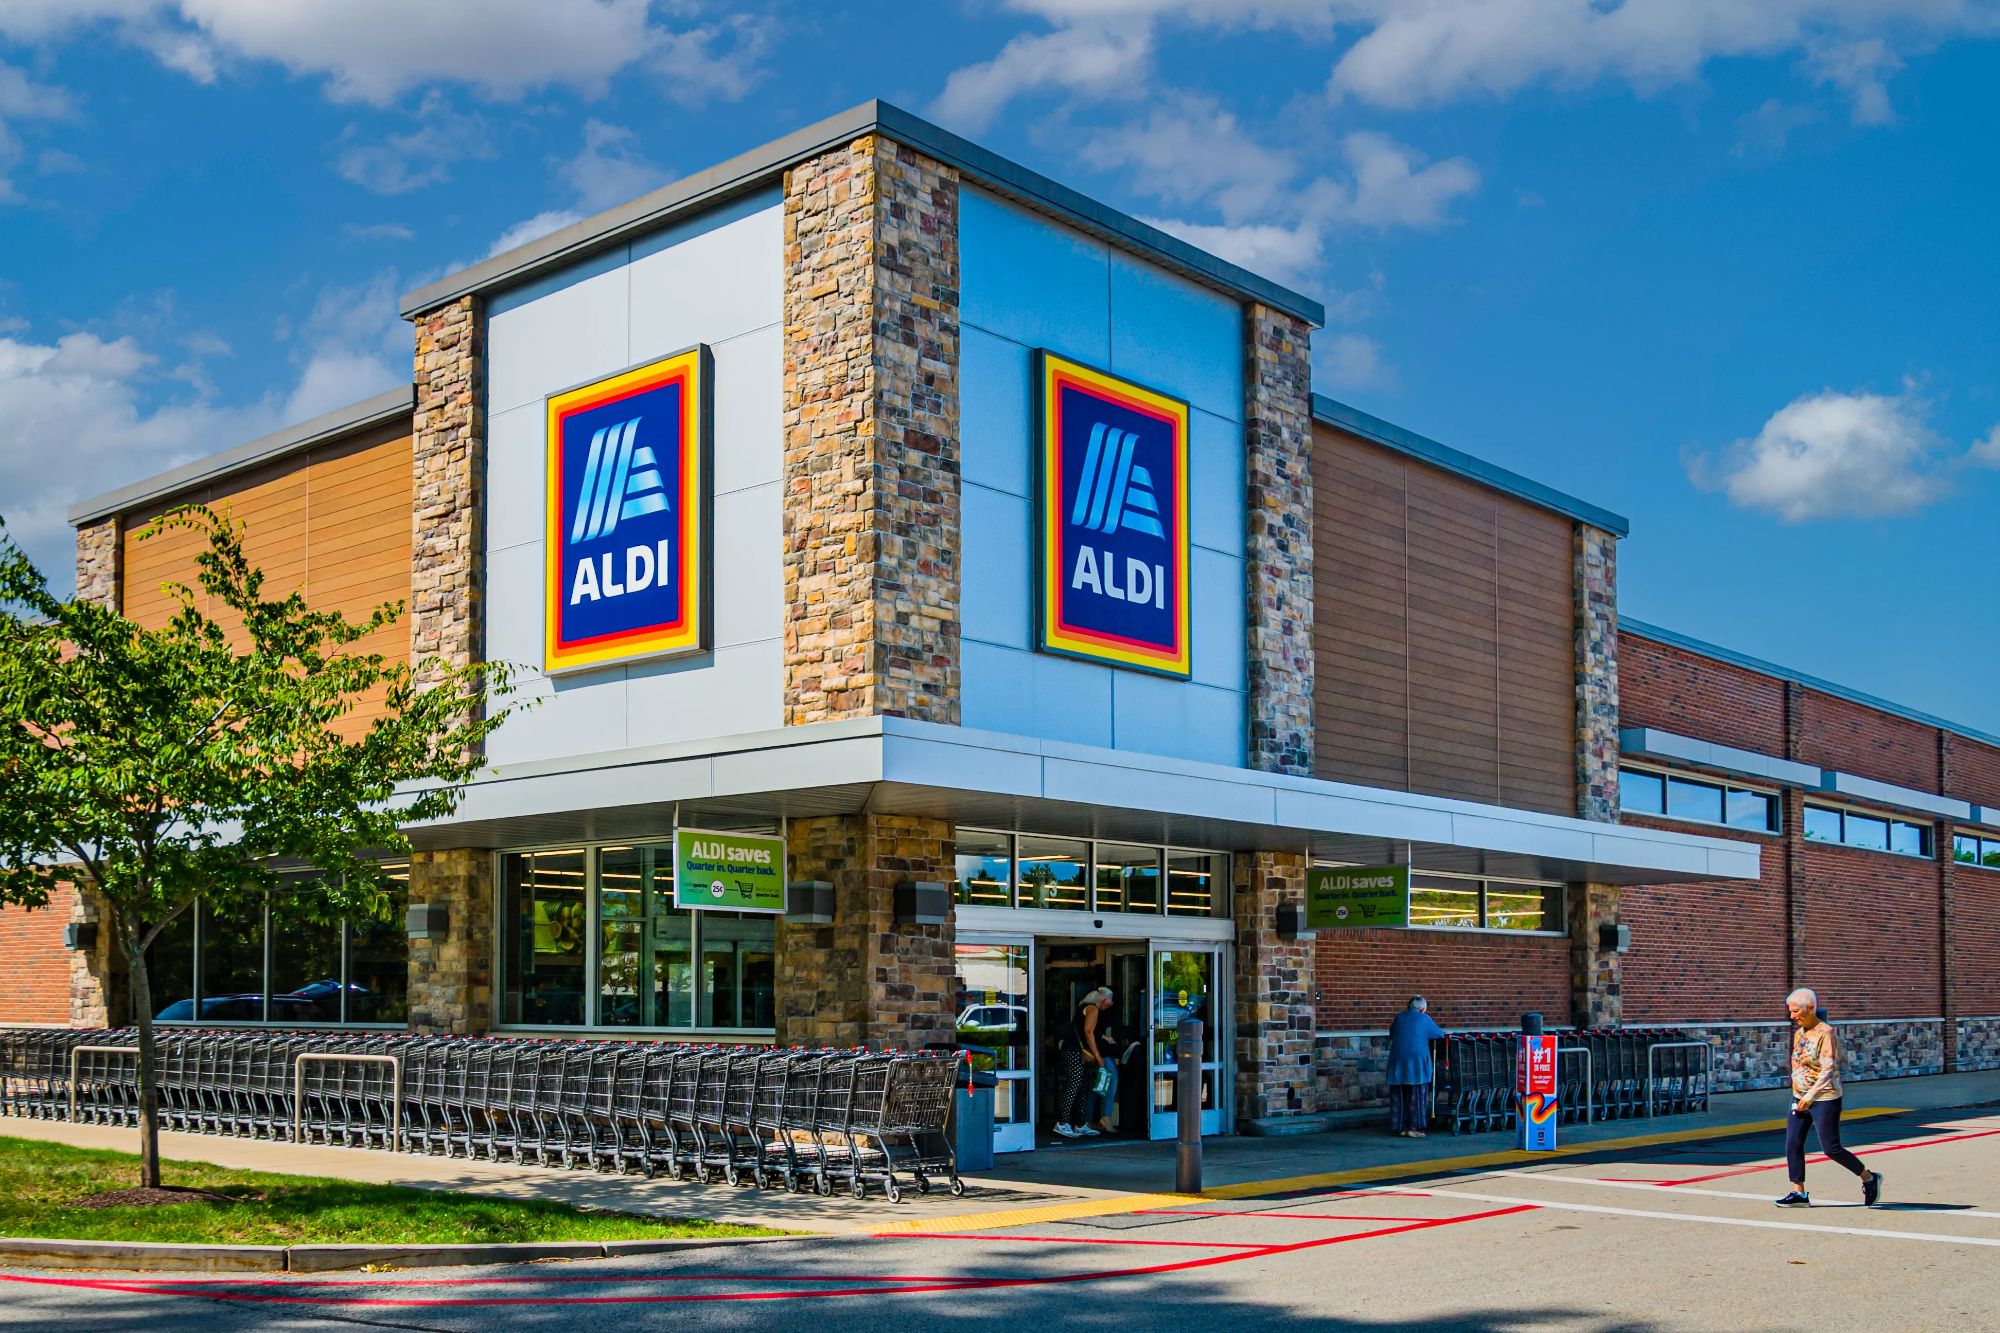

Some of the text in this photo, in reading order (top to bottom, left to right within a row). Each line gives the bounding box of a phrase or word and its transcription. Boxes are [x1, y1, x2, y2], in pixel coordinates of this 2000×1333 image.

[569, 539, 669, 606] ALDI
[1071, 544, 1165, 610] ALDI
[691, 841, 771, 864] ALDI saves
[686, 861, 776, 876] Quarter in. Quarter back.
[1320, 876, 1394, 890] ALDI saves
[1533, 1048, 1551, 1063] #1
